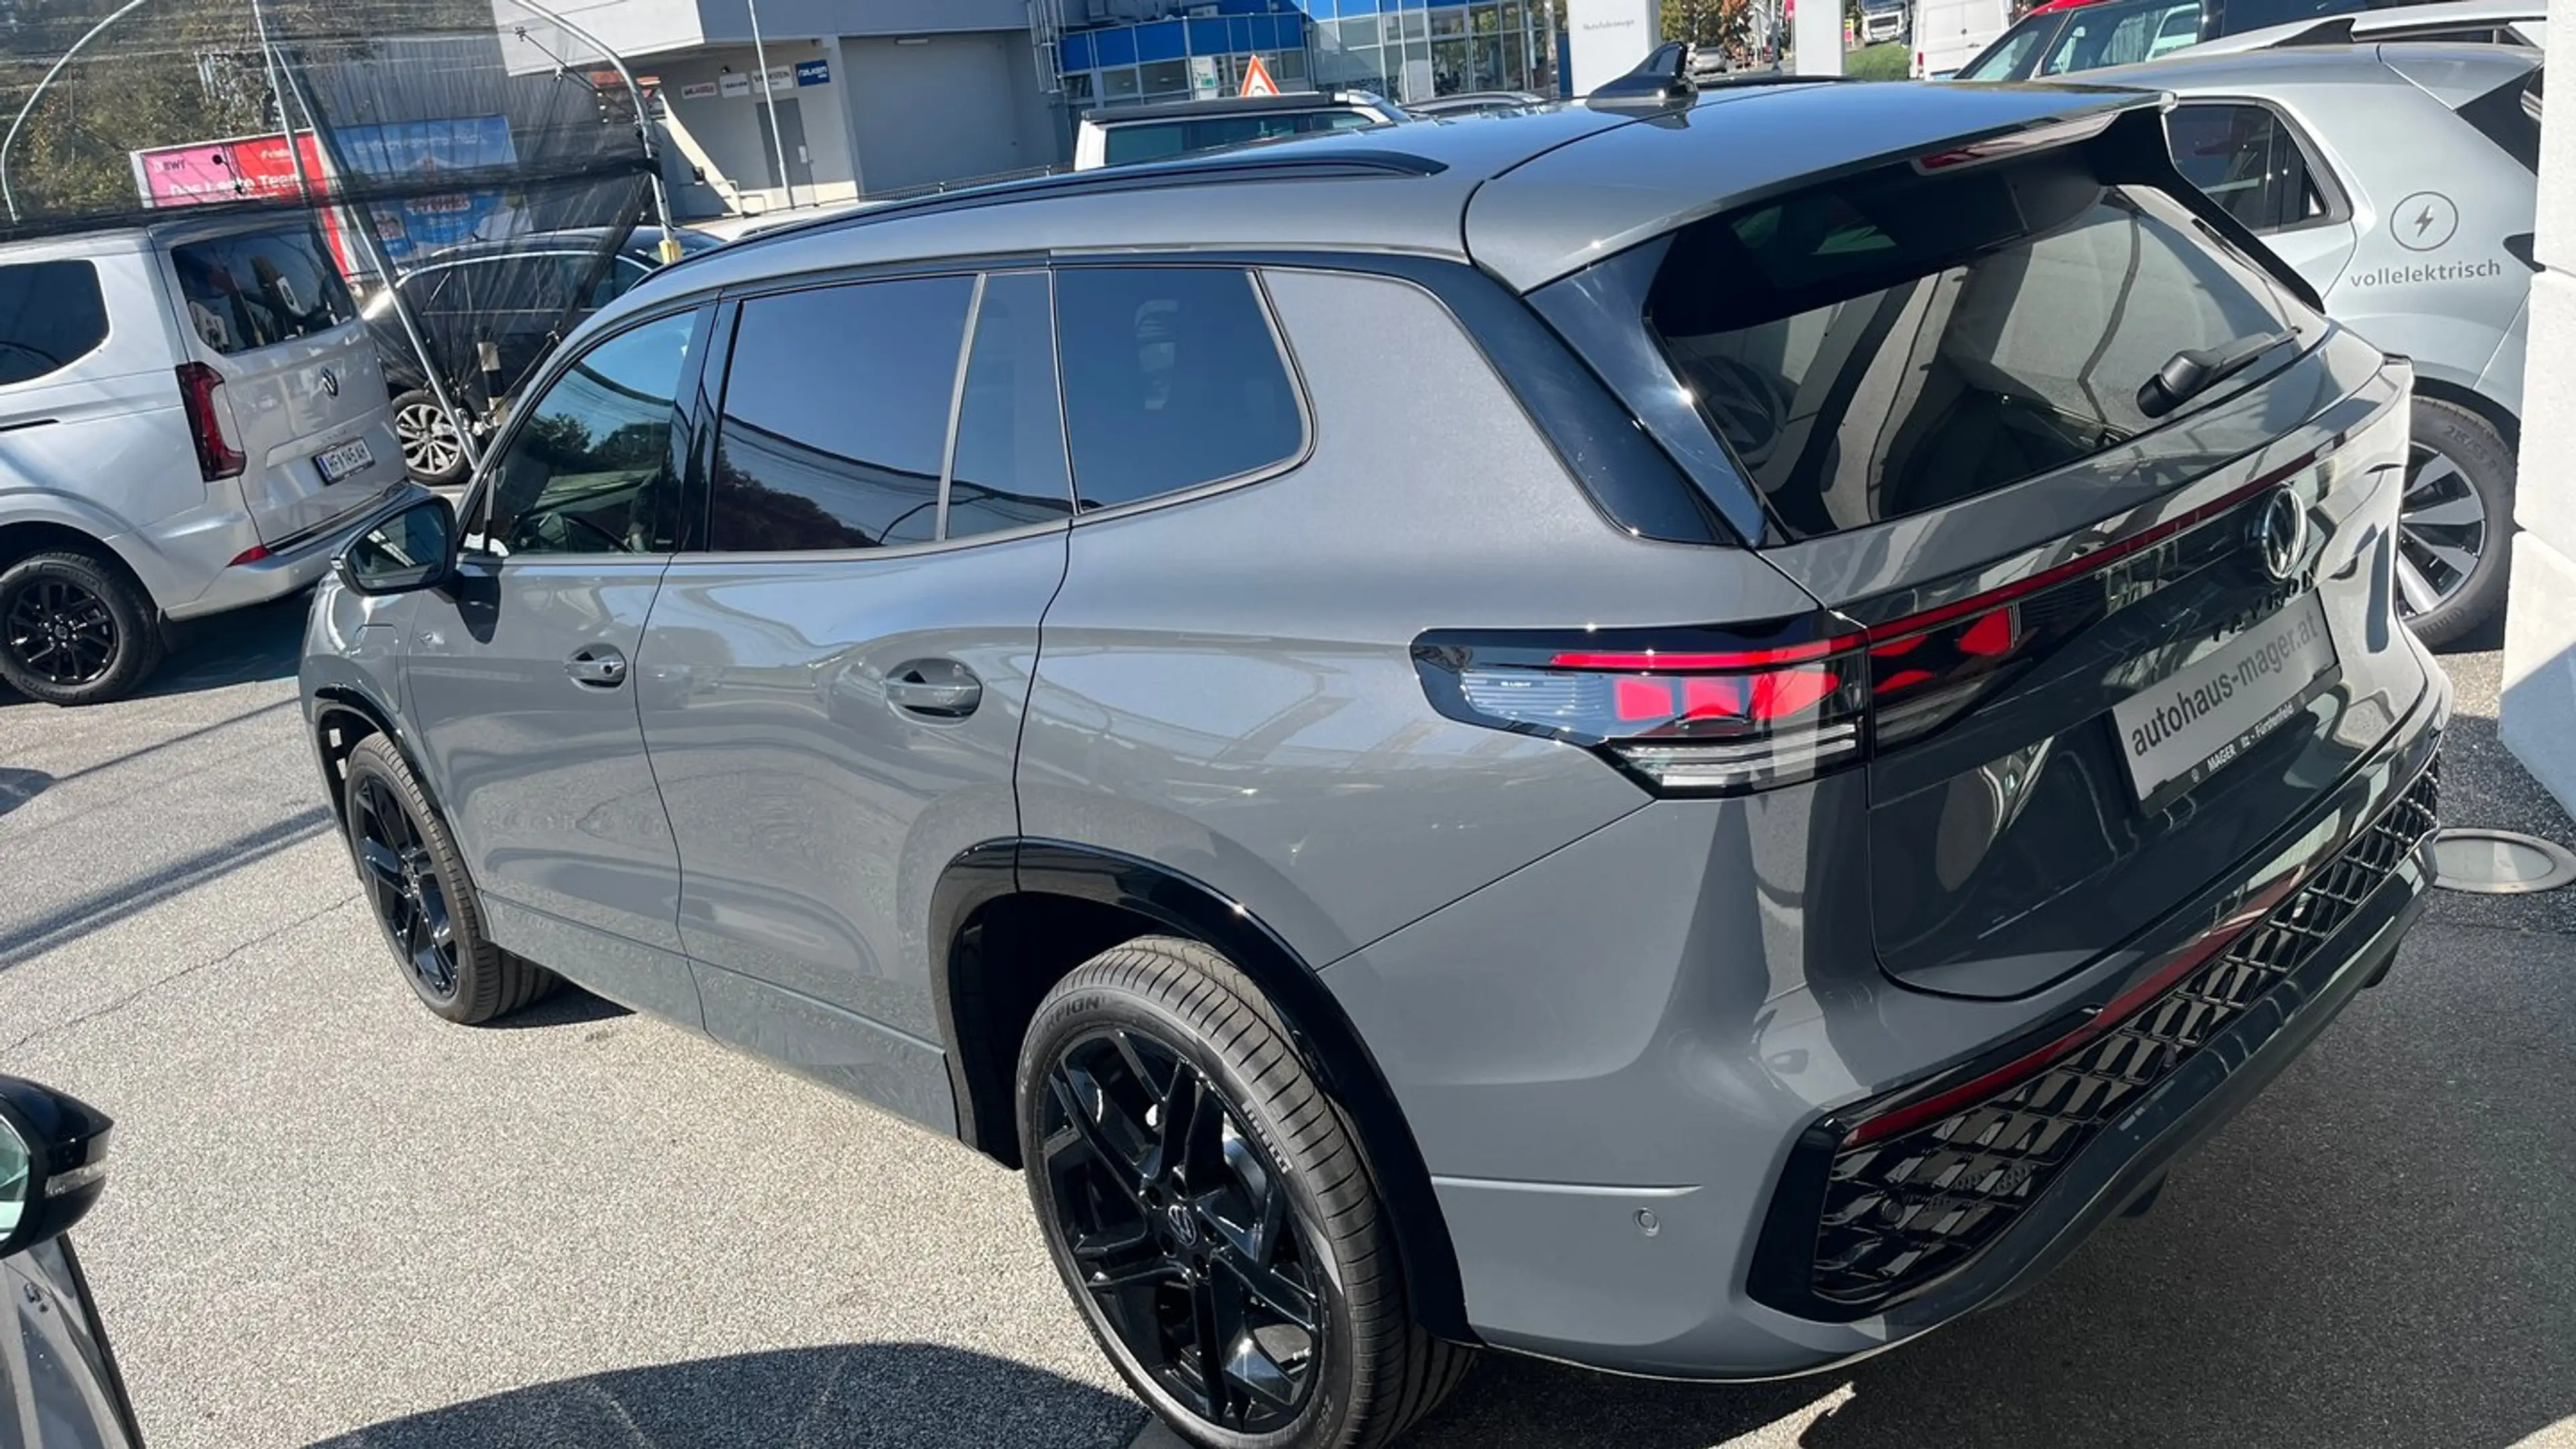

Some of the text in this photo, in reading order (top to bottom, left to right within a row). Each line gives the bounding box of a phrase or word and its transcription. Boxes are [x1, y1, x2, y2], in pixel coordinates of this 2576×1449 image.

[2351, 259, 2501, 287] vollelektrisch
[2132, 610, 2319, 756] autohaus-mager.at
[2207, 743, 2237, 772] MAGER
